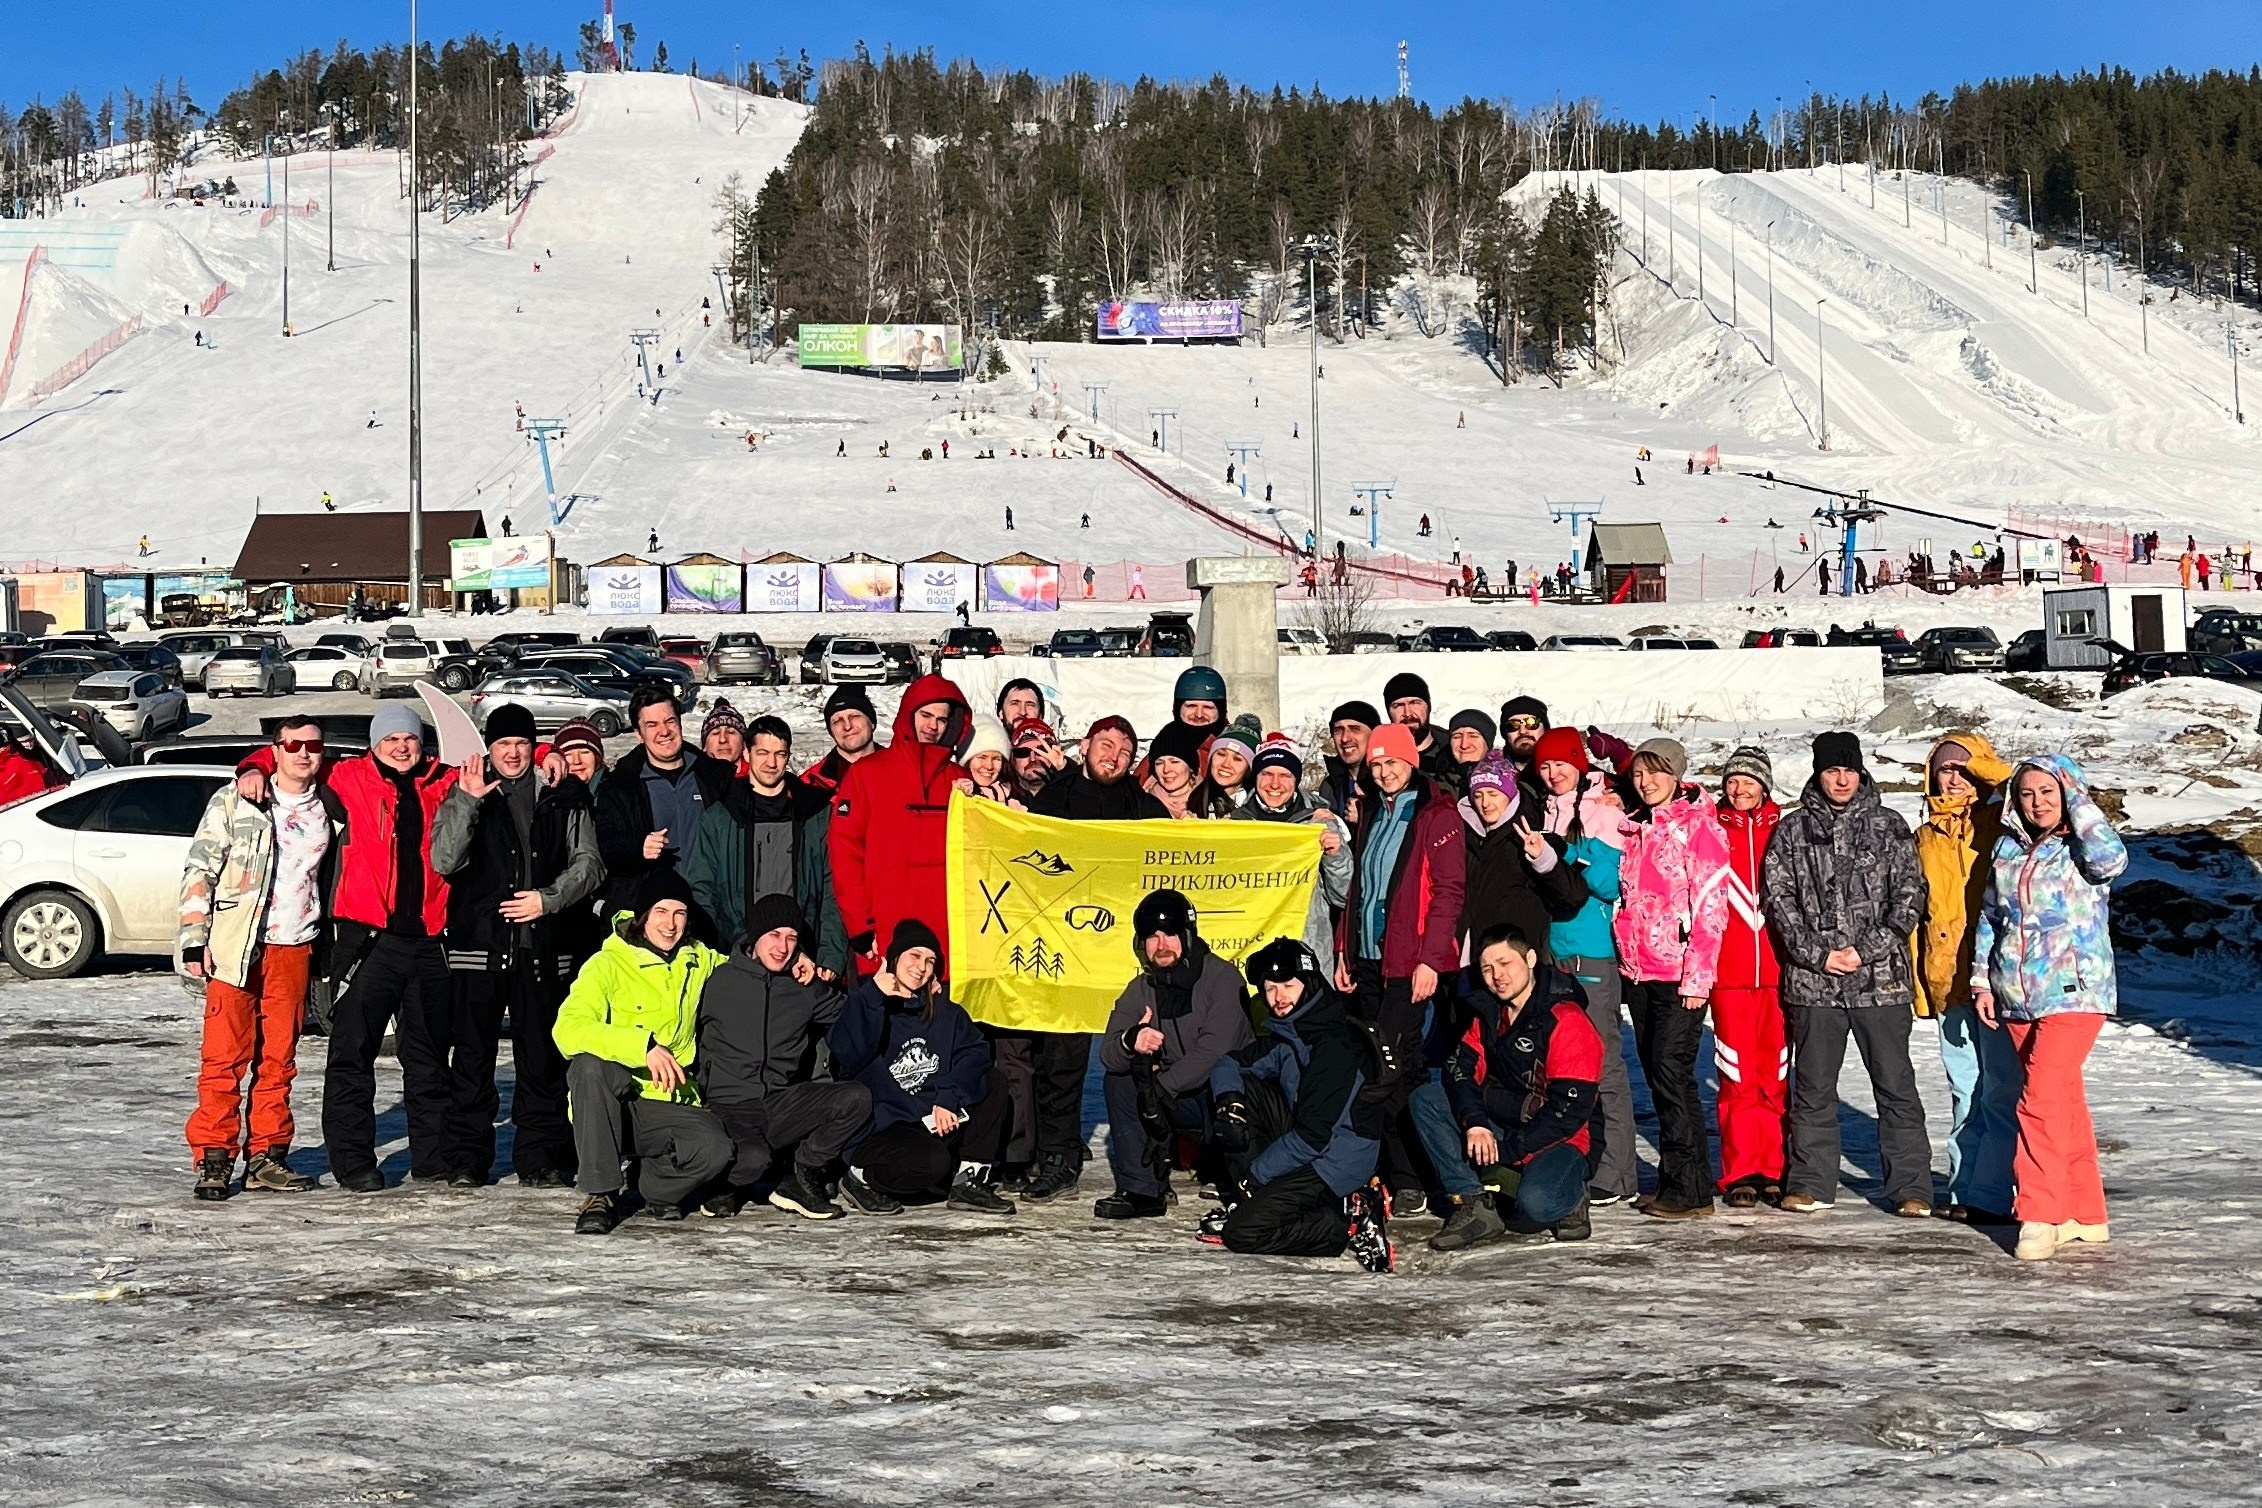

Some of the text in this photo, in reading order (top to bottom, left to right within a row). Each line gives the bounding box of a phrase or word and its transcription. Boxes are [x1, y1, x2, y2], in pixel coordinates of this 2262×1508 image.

[1159, 305, 1232, 317] СКИДКА 10%
[803, 340, 858, 352] ОЛКОН
[1144, 850, 1216, 865] ВРЕМЯ
